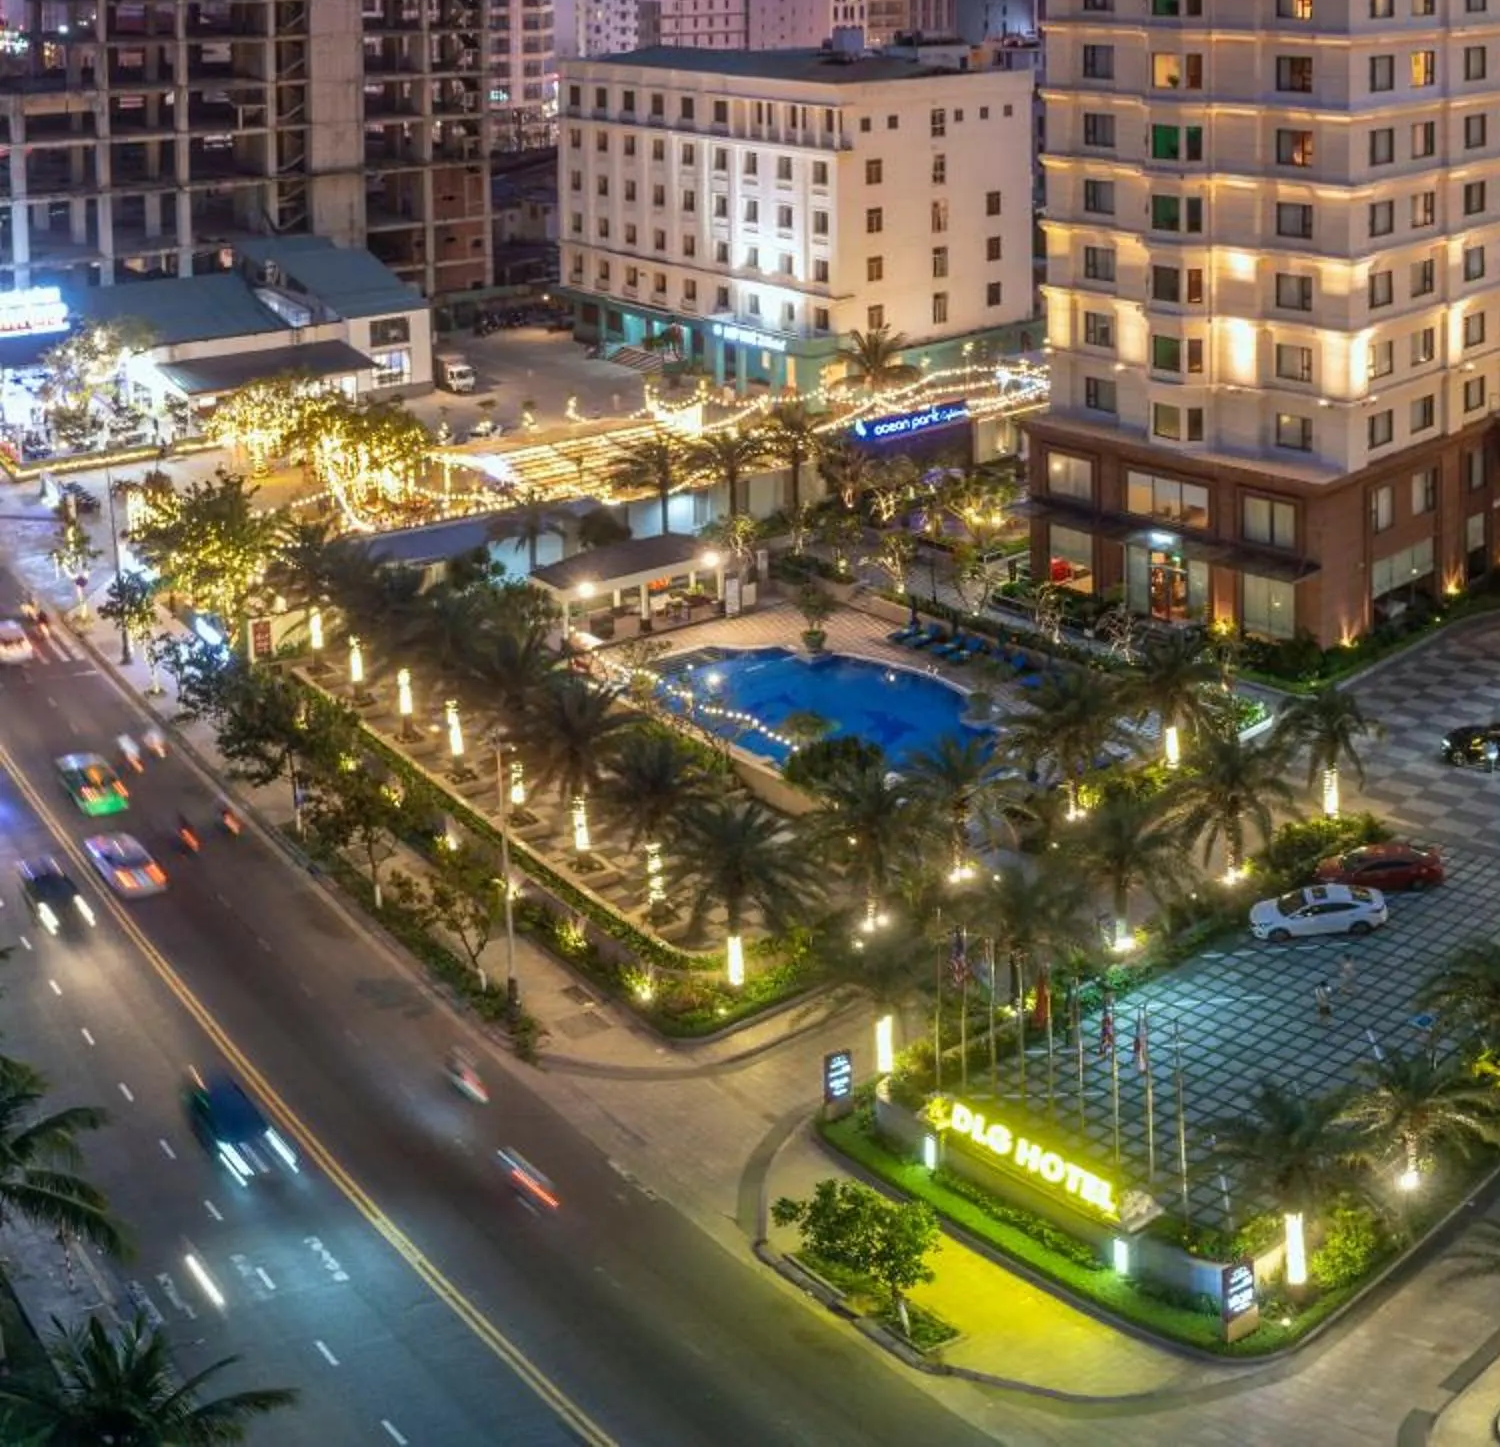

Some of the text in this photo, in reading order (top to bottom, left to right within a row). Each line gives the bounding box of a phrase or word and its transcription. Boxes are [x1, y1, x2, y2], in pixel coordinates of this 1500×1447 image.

[873, 419, 911, 436] ocean
[911, 406, 939, 430] park
[951, 1101, 1116, 1214] DLG HOTEL
